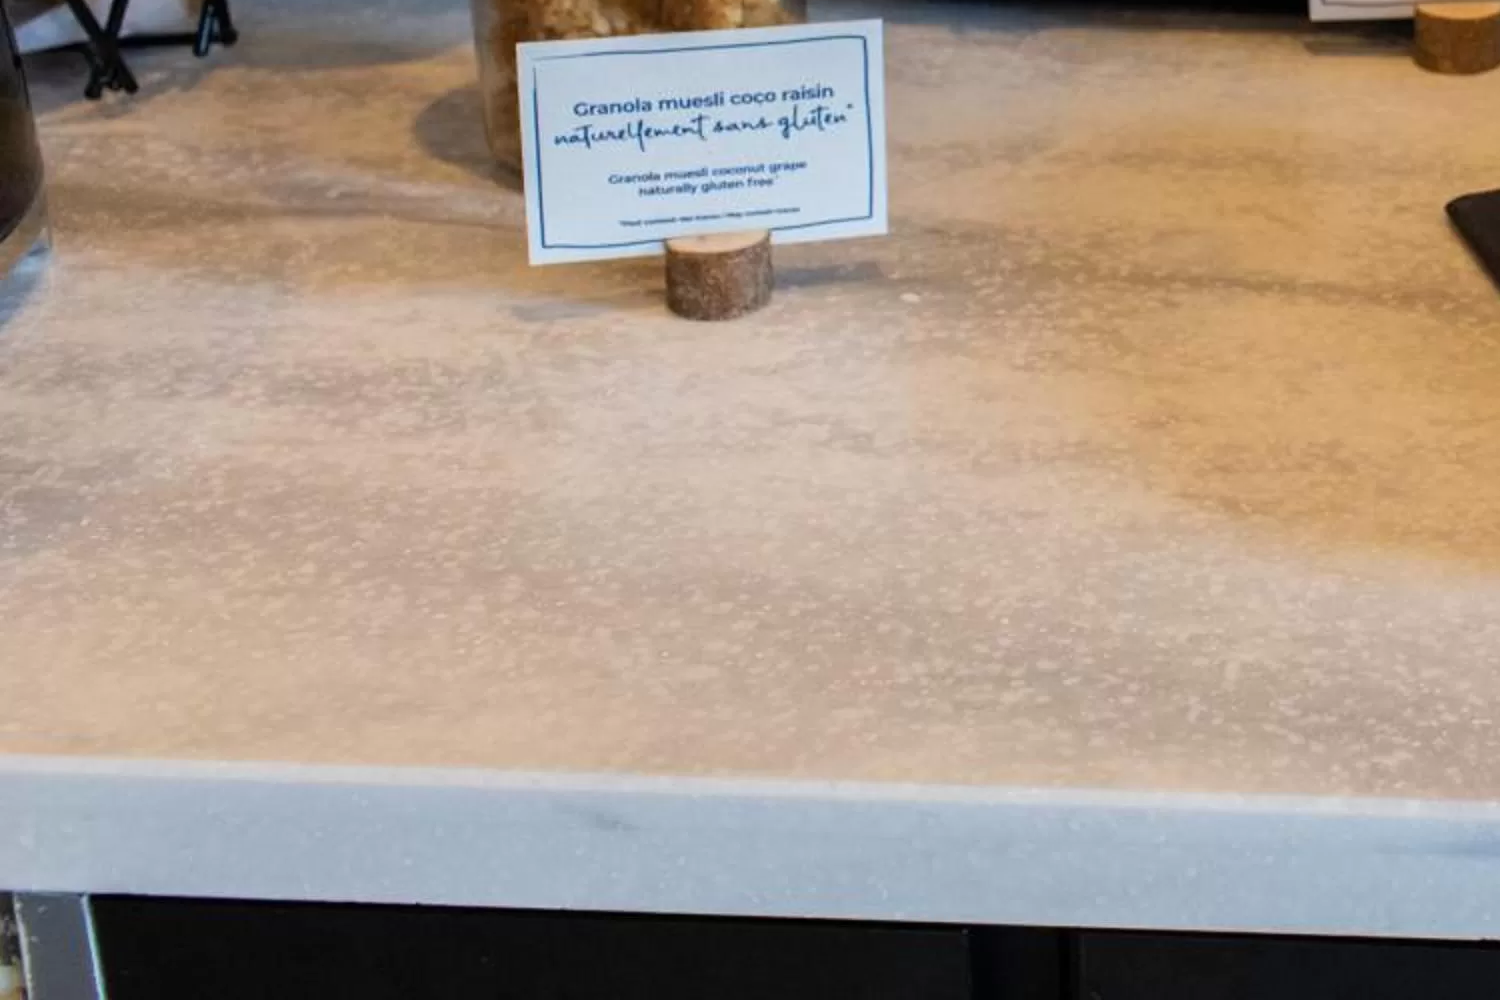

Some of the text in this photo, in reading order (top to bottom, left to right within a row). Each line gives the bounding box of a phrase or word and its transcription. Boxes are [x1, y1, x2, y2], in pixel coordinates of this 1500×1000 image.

[573, 99, 652, 117] Granola
[658, 91, 725, 111] muesli
[782, 83, 835, 101] raisin
[713, 115, 773, 134] sans
[608, 159, 808, 185] Granola muesli coconut grape
[638, 182, 698, 197] naturally
[701, 177, 745, 193] gluten
